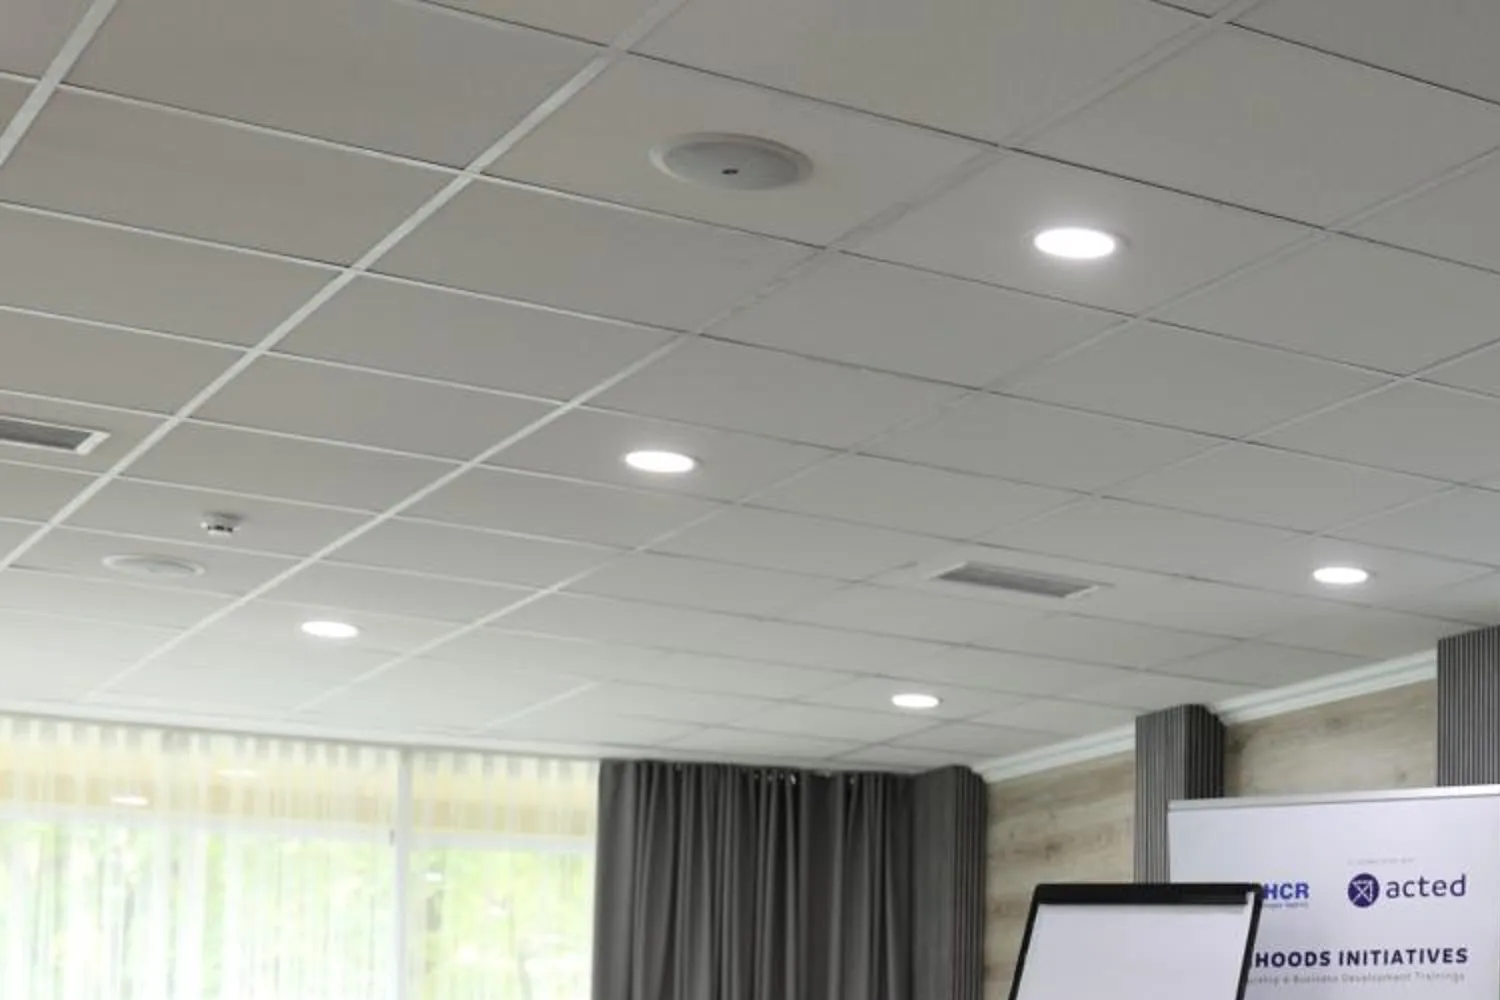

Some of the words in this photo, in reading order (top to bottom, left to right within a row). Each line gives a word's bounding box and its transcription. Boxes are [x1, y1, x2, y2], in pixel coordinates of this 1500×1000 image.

[1263, 883, 1309, 899] HCR
[1385, 873, 1467, 899] acted
[1255, 951, 1331, 968] HOODS
[1339, 948, 1468, 967] INITIATIVES
